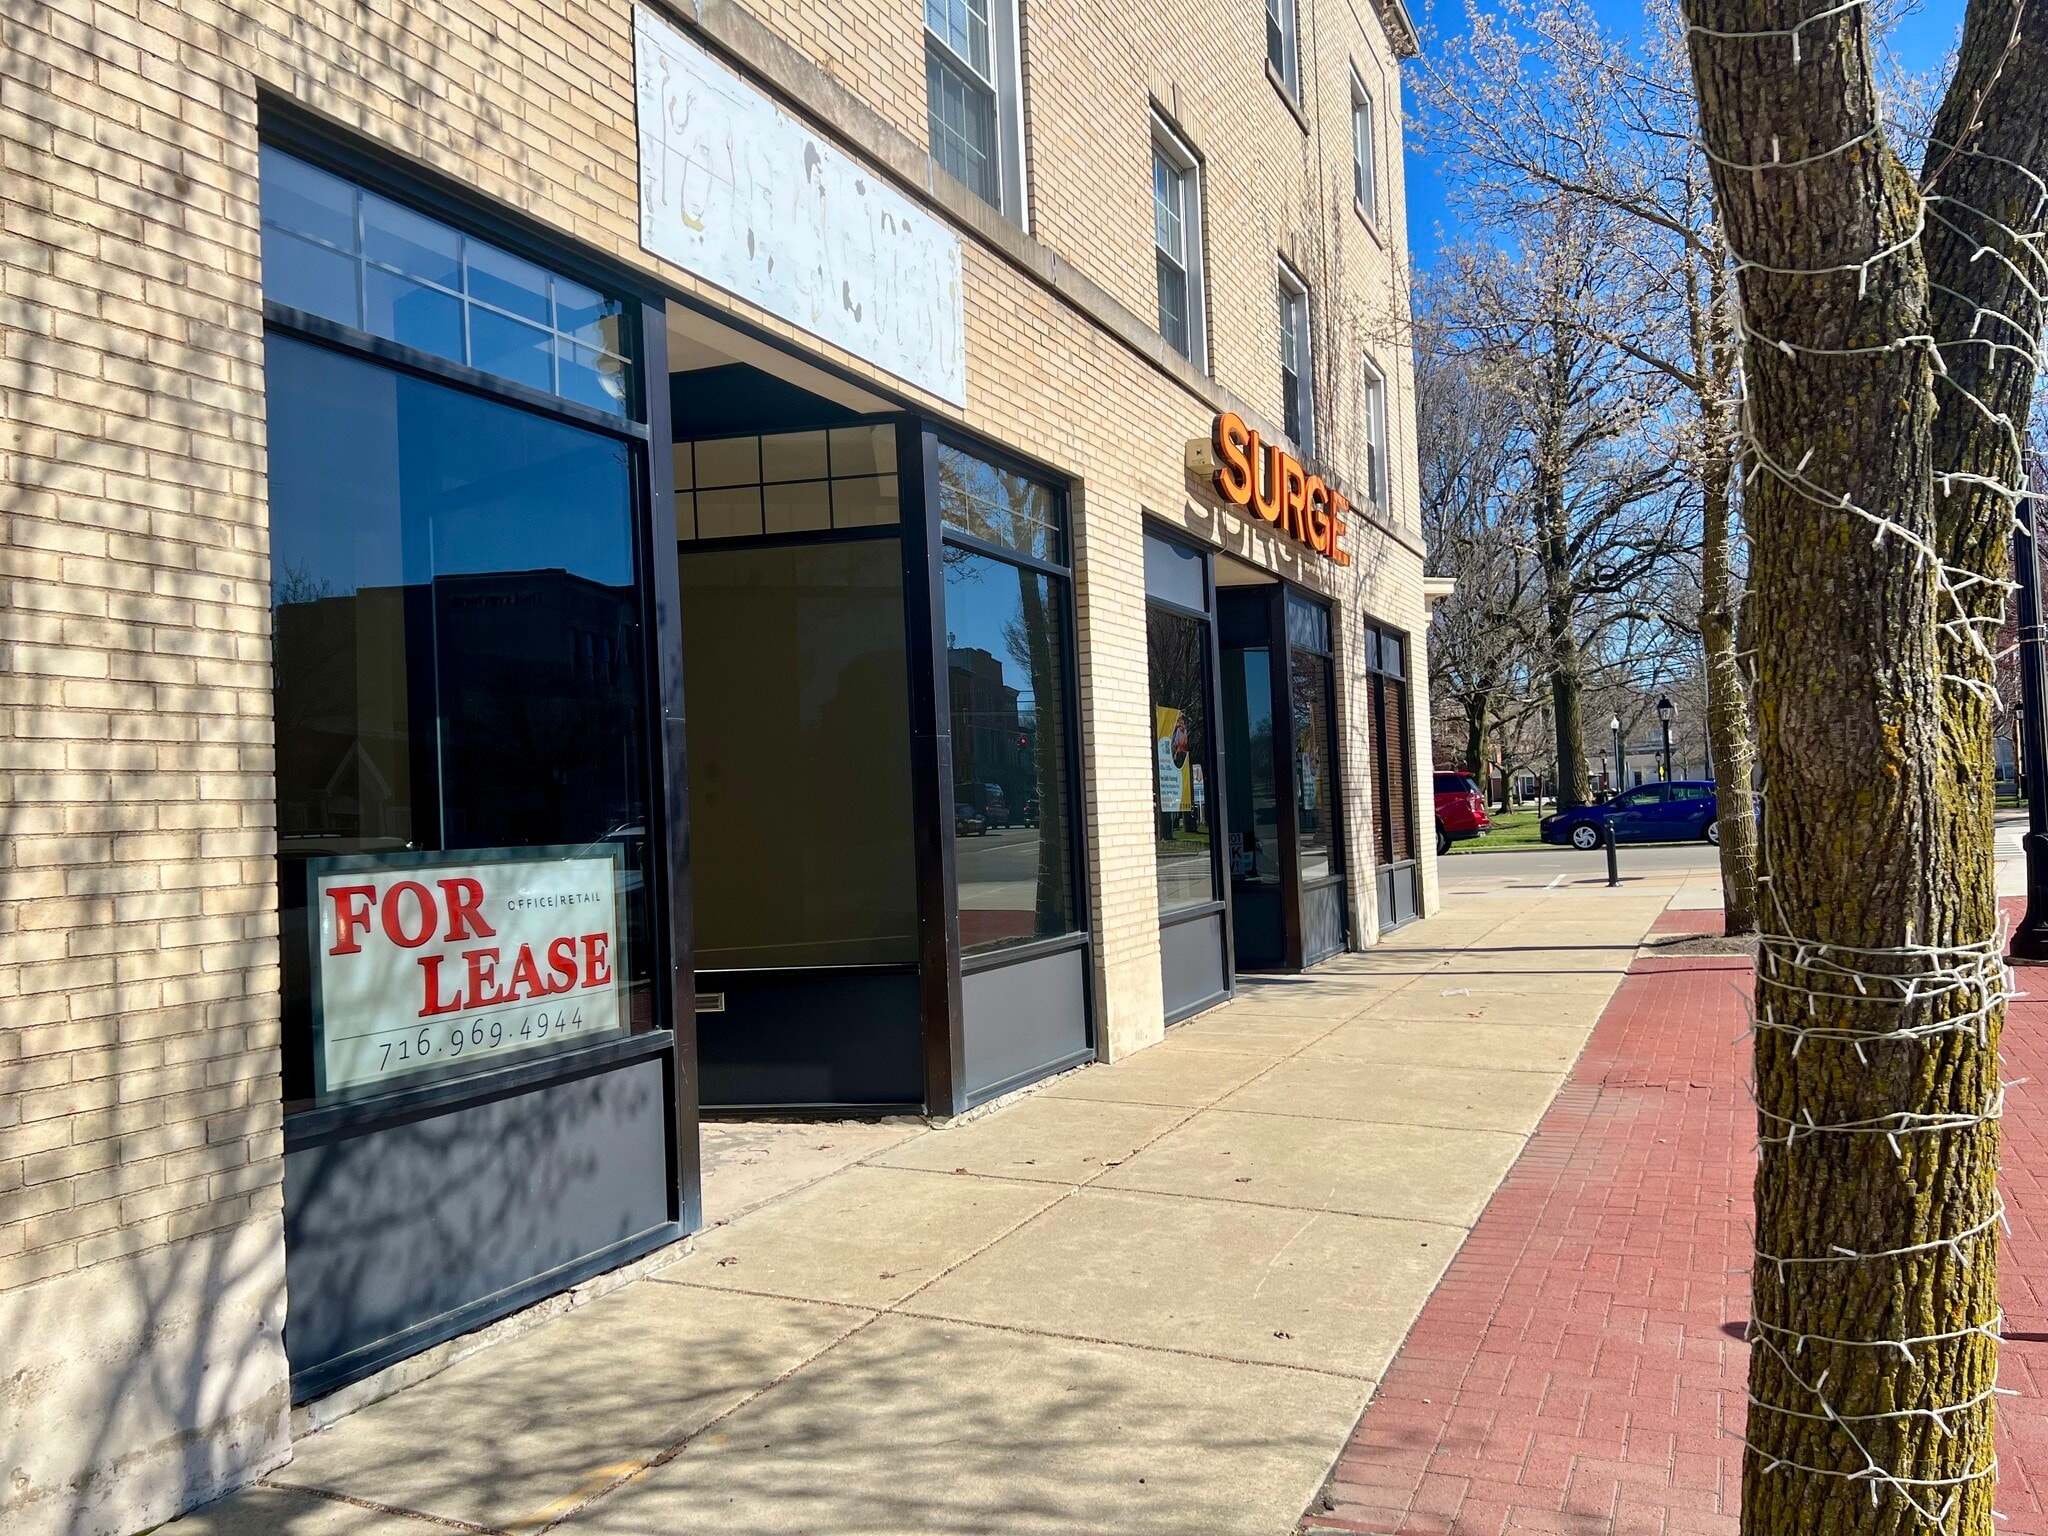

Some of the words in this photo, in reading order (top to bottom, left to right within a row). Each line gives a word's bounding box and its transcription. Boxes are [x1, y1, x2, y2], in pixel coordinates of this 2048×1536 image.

[1212, 412, 1350, 567] SURGE
[326, 877, 496, 956] FOR
[417, 932, 611, 1018] LEASE
[379, 1006, 583, 1071] 716.969.4944
